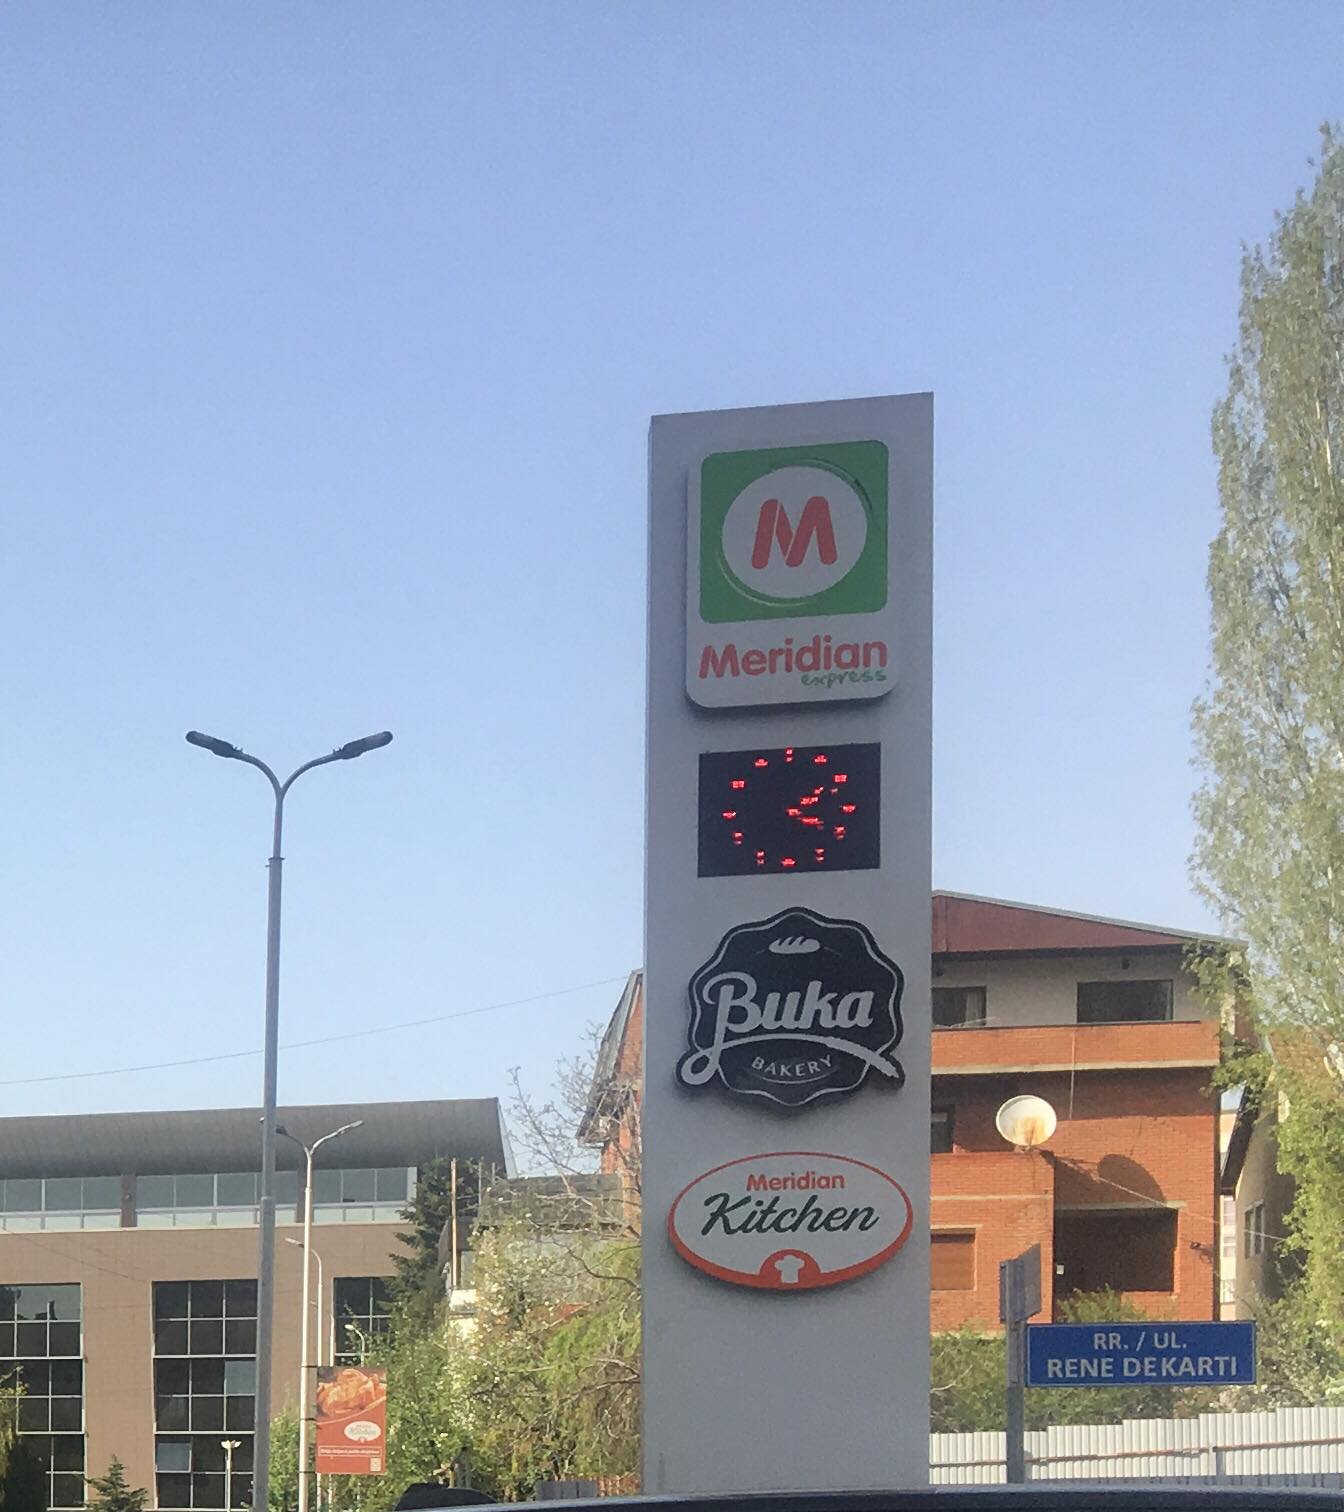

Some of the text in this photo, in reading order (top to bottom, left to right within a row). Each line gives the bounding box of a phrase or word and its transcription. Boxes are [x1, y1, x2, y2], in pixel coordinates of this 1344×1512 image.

[698, 635, 888, 679] Meridian
[801, 670, 888, 688] express
[697, 971, 874, 1050] Buka
[751, 1054, 834, 1078] BAKERY
[745, 1171, 846, 1192] Meridian
[701, 1193, 879, 1236] Kitchen
[1093, 1332, 1129, 1350] RR.
[1153, 1331, 1188, 1349] UL.
[1047, 1355, 1238, 1378] RENE DEKARTI
